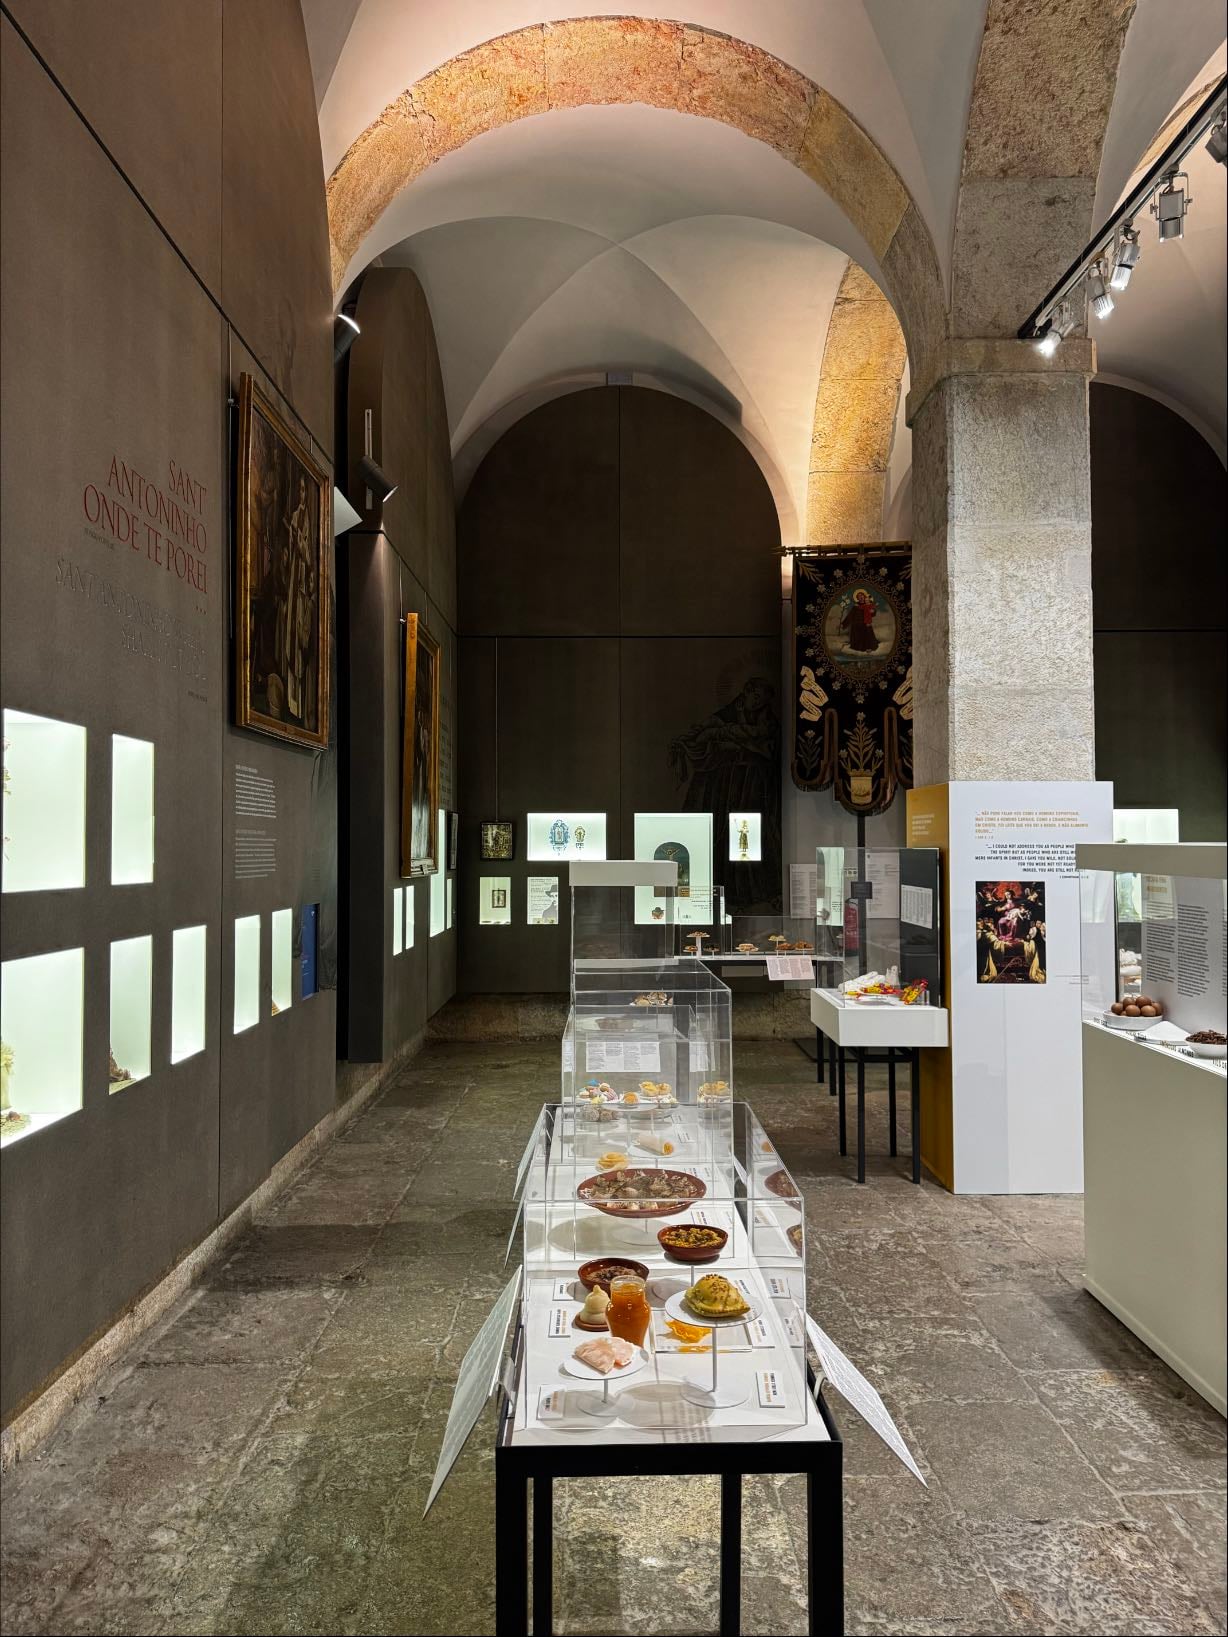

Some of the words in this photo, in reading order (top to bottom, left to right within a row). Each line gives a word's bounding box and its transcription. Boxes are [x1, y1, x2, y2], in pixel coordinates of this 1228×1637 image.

[108, 455, 207, 554] ANTONINHO
[168, 459, 207, 515] SANT
[83, 484, 140, 551] ONDE
[143, 521, 162, 566] TE
[164, 537, 208, 595] POREI
